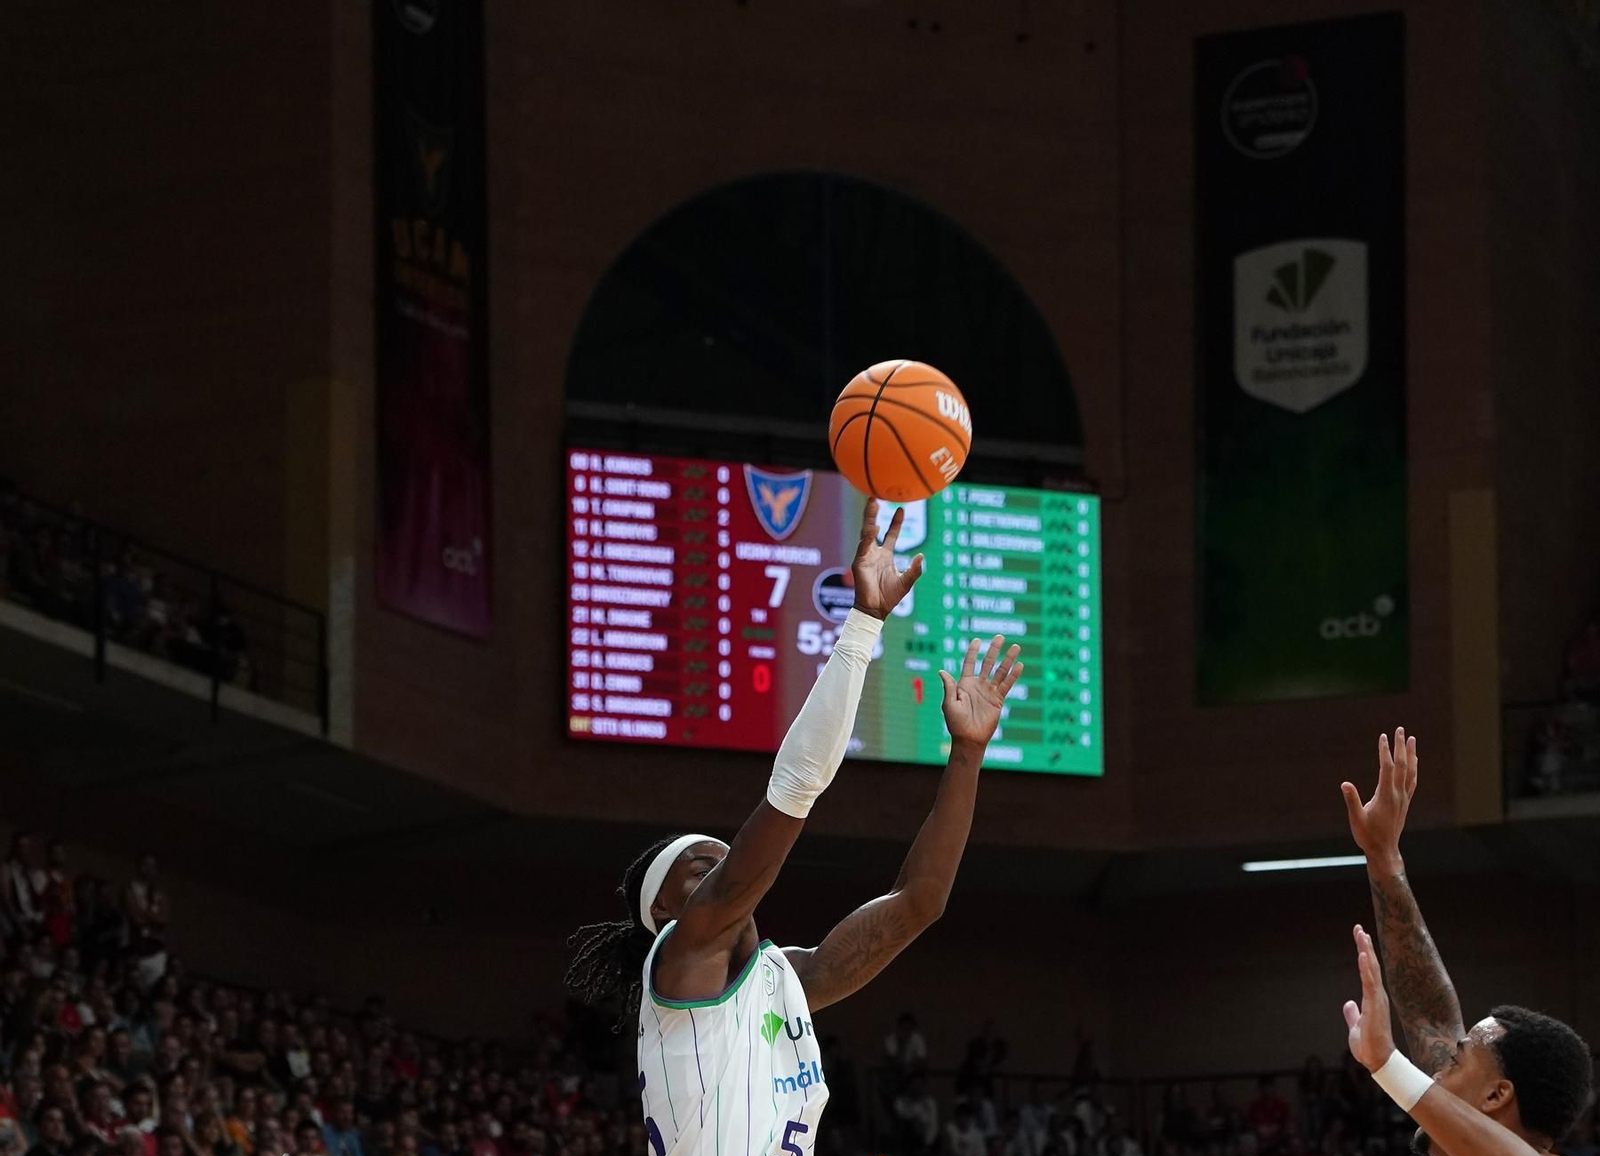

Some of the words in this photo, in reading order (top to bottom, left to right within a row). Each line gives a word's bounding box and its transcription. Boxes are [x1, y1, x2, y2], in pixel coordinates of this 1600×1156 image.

[765, 566, 790, 608] 7
[1320, 611, 1380, 640] acb
[753, 665, 770, 693] 0
[912, 677, 924, 704] 1
